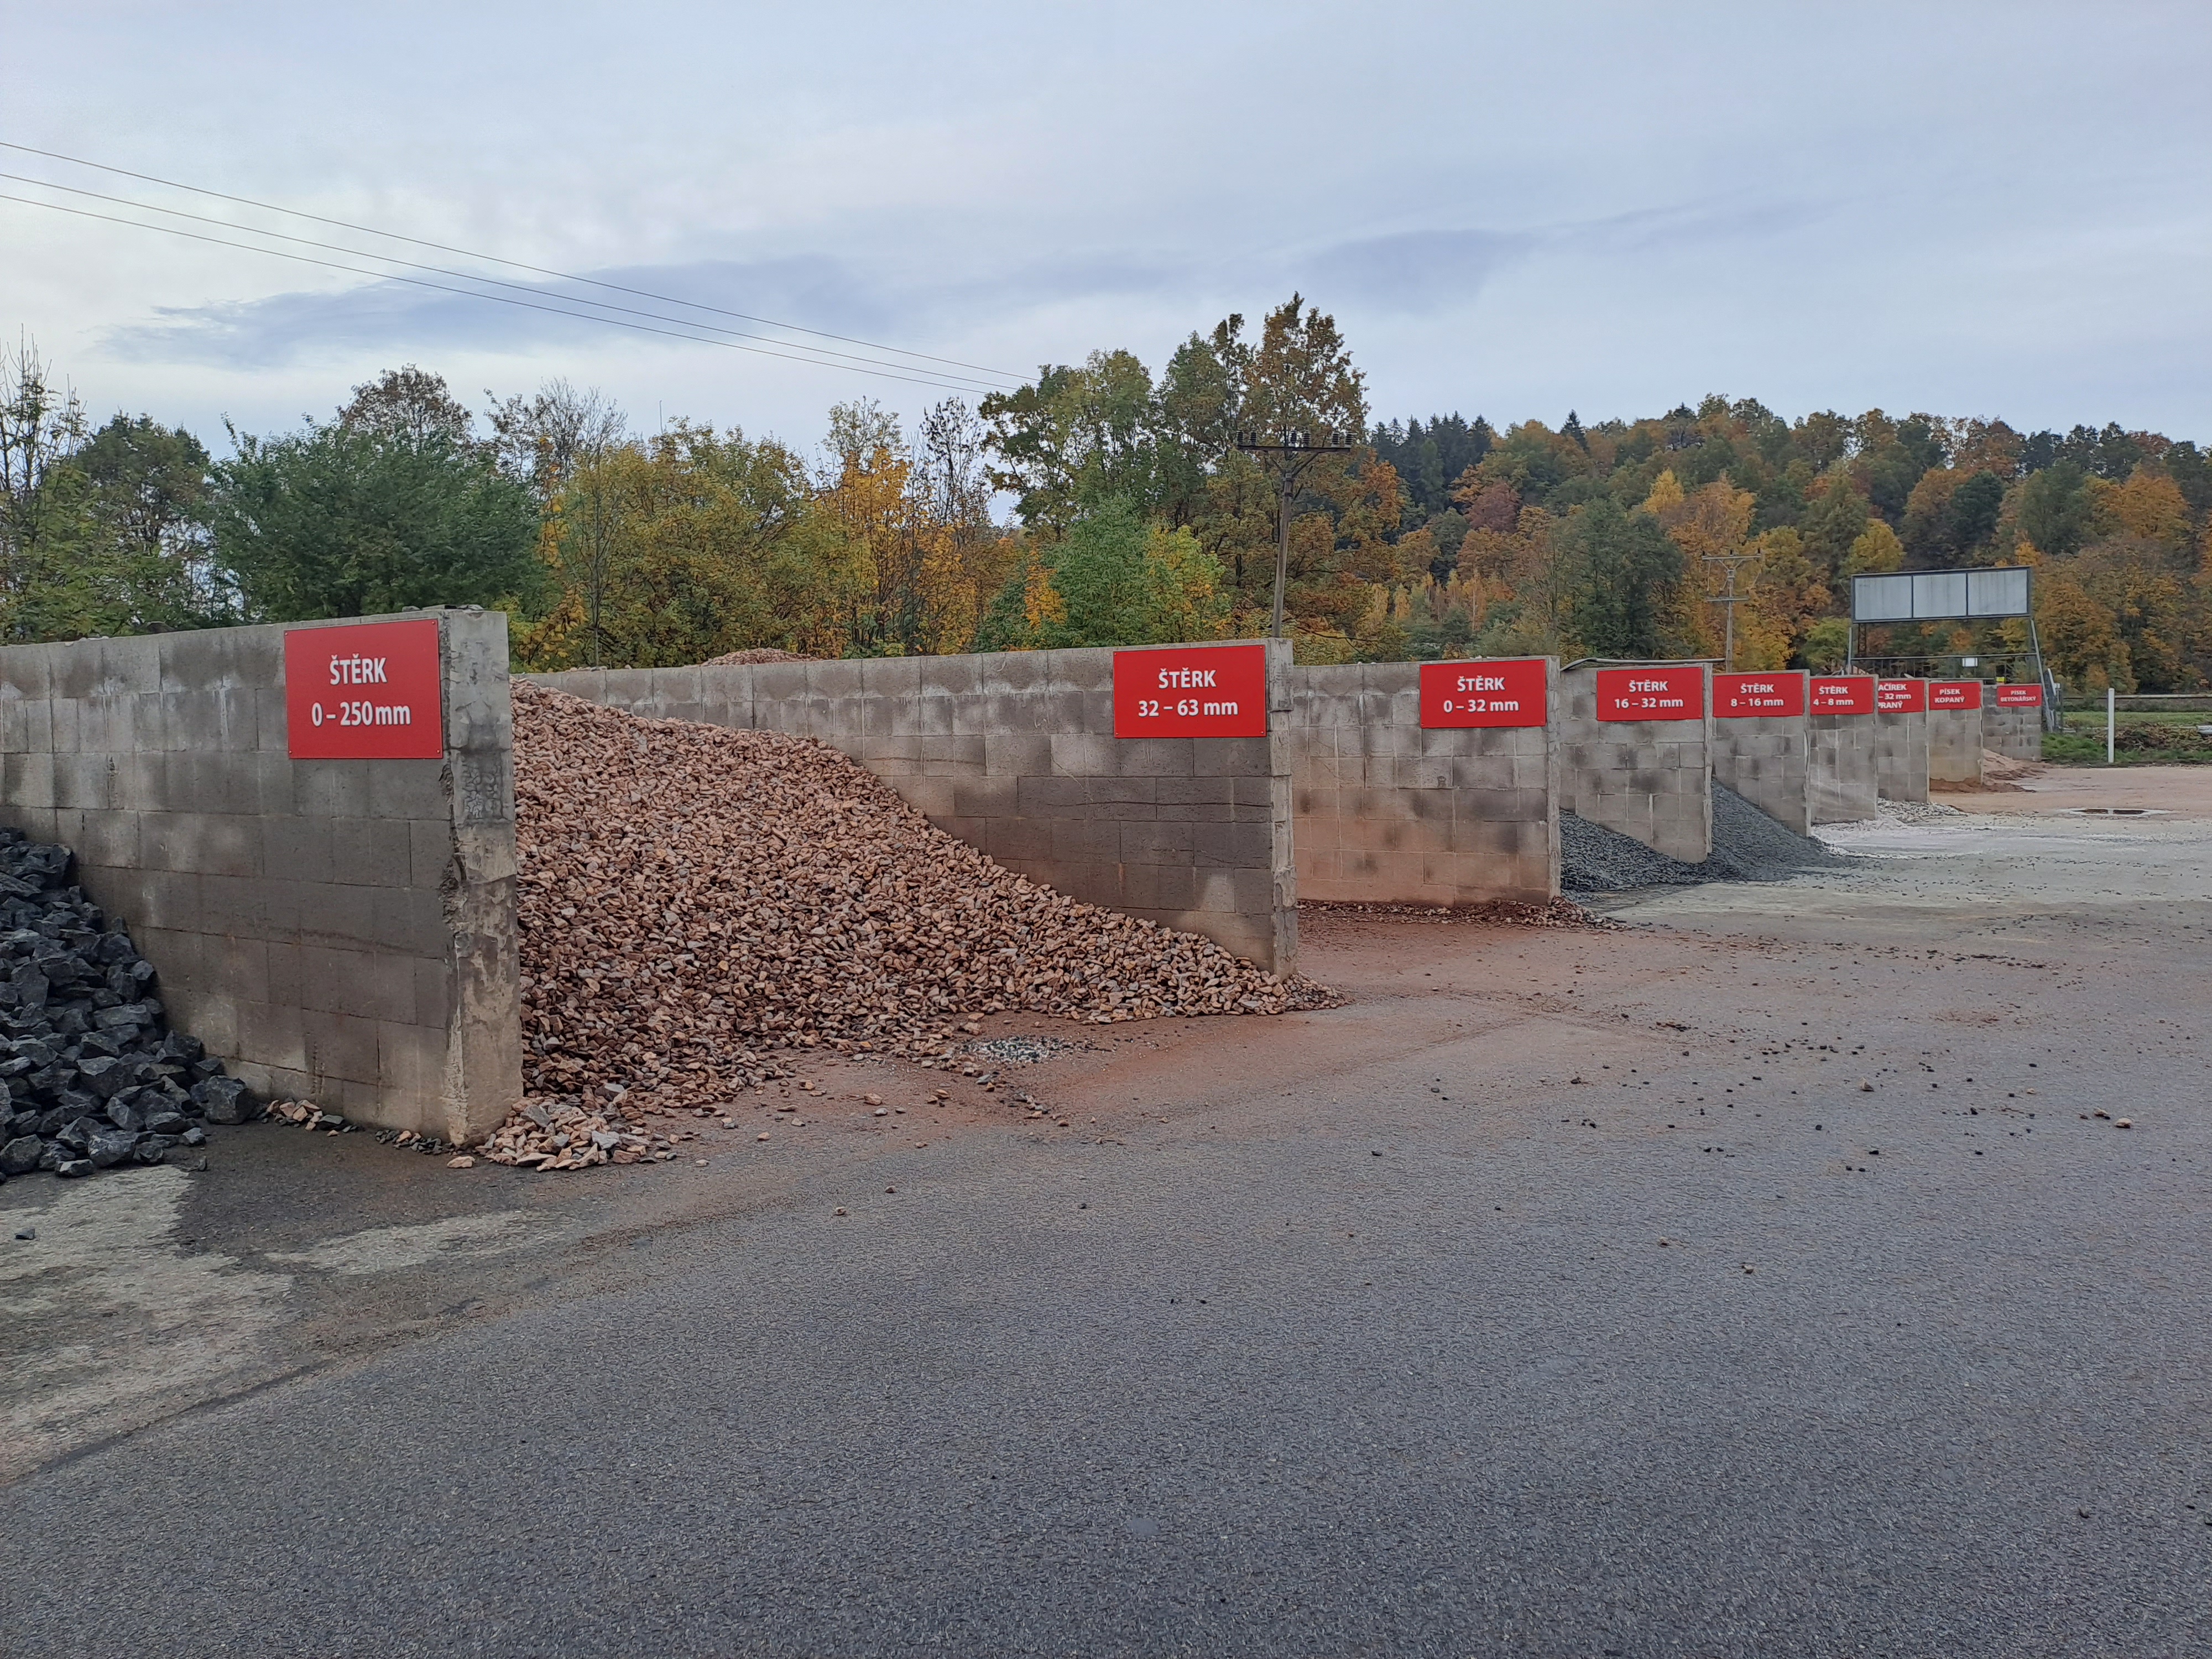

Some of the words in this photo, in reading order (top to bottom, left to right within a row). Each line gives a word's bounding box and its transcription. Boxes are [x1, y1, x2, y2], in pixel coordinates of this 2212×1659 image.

[330, 653, 387, 685] ŠTĚRK
[1159, 667, 1217, 688] ŠTĚRK
[1457, 675, 1505, 692] ŠTĚRK
[1629, 679, 1668, 692] ŠTĚRK
[1740, 683, 1774, 693] ŠTĚRK
[1819, 685, 1848, 695] ŠTĚRK
[1878, 683, 1907, 691] AČÍREK
[1138, 700, 1159, 717] 32
[1177, 699, 1199, 716] 63
[1204, 702, 1238, 716] mm
[1443, 700, 1453, 713] 0
[1468, 699, 1486, 712] 32
[1490, 700, 1519, 712] mm
[1614, 698, 1629, 708] 16
[1641, 697, 1657, 708] 32
[1660, 699, 1683, 707] mm
[1730, 698, 1738, 707] 8
[1749, 698, 1761, 707] 16
[311, 702, 322, 726] 0
[340, 701, 373, 726] 250
[375, 705, 410, 725] mm
